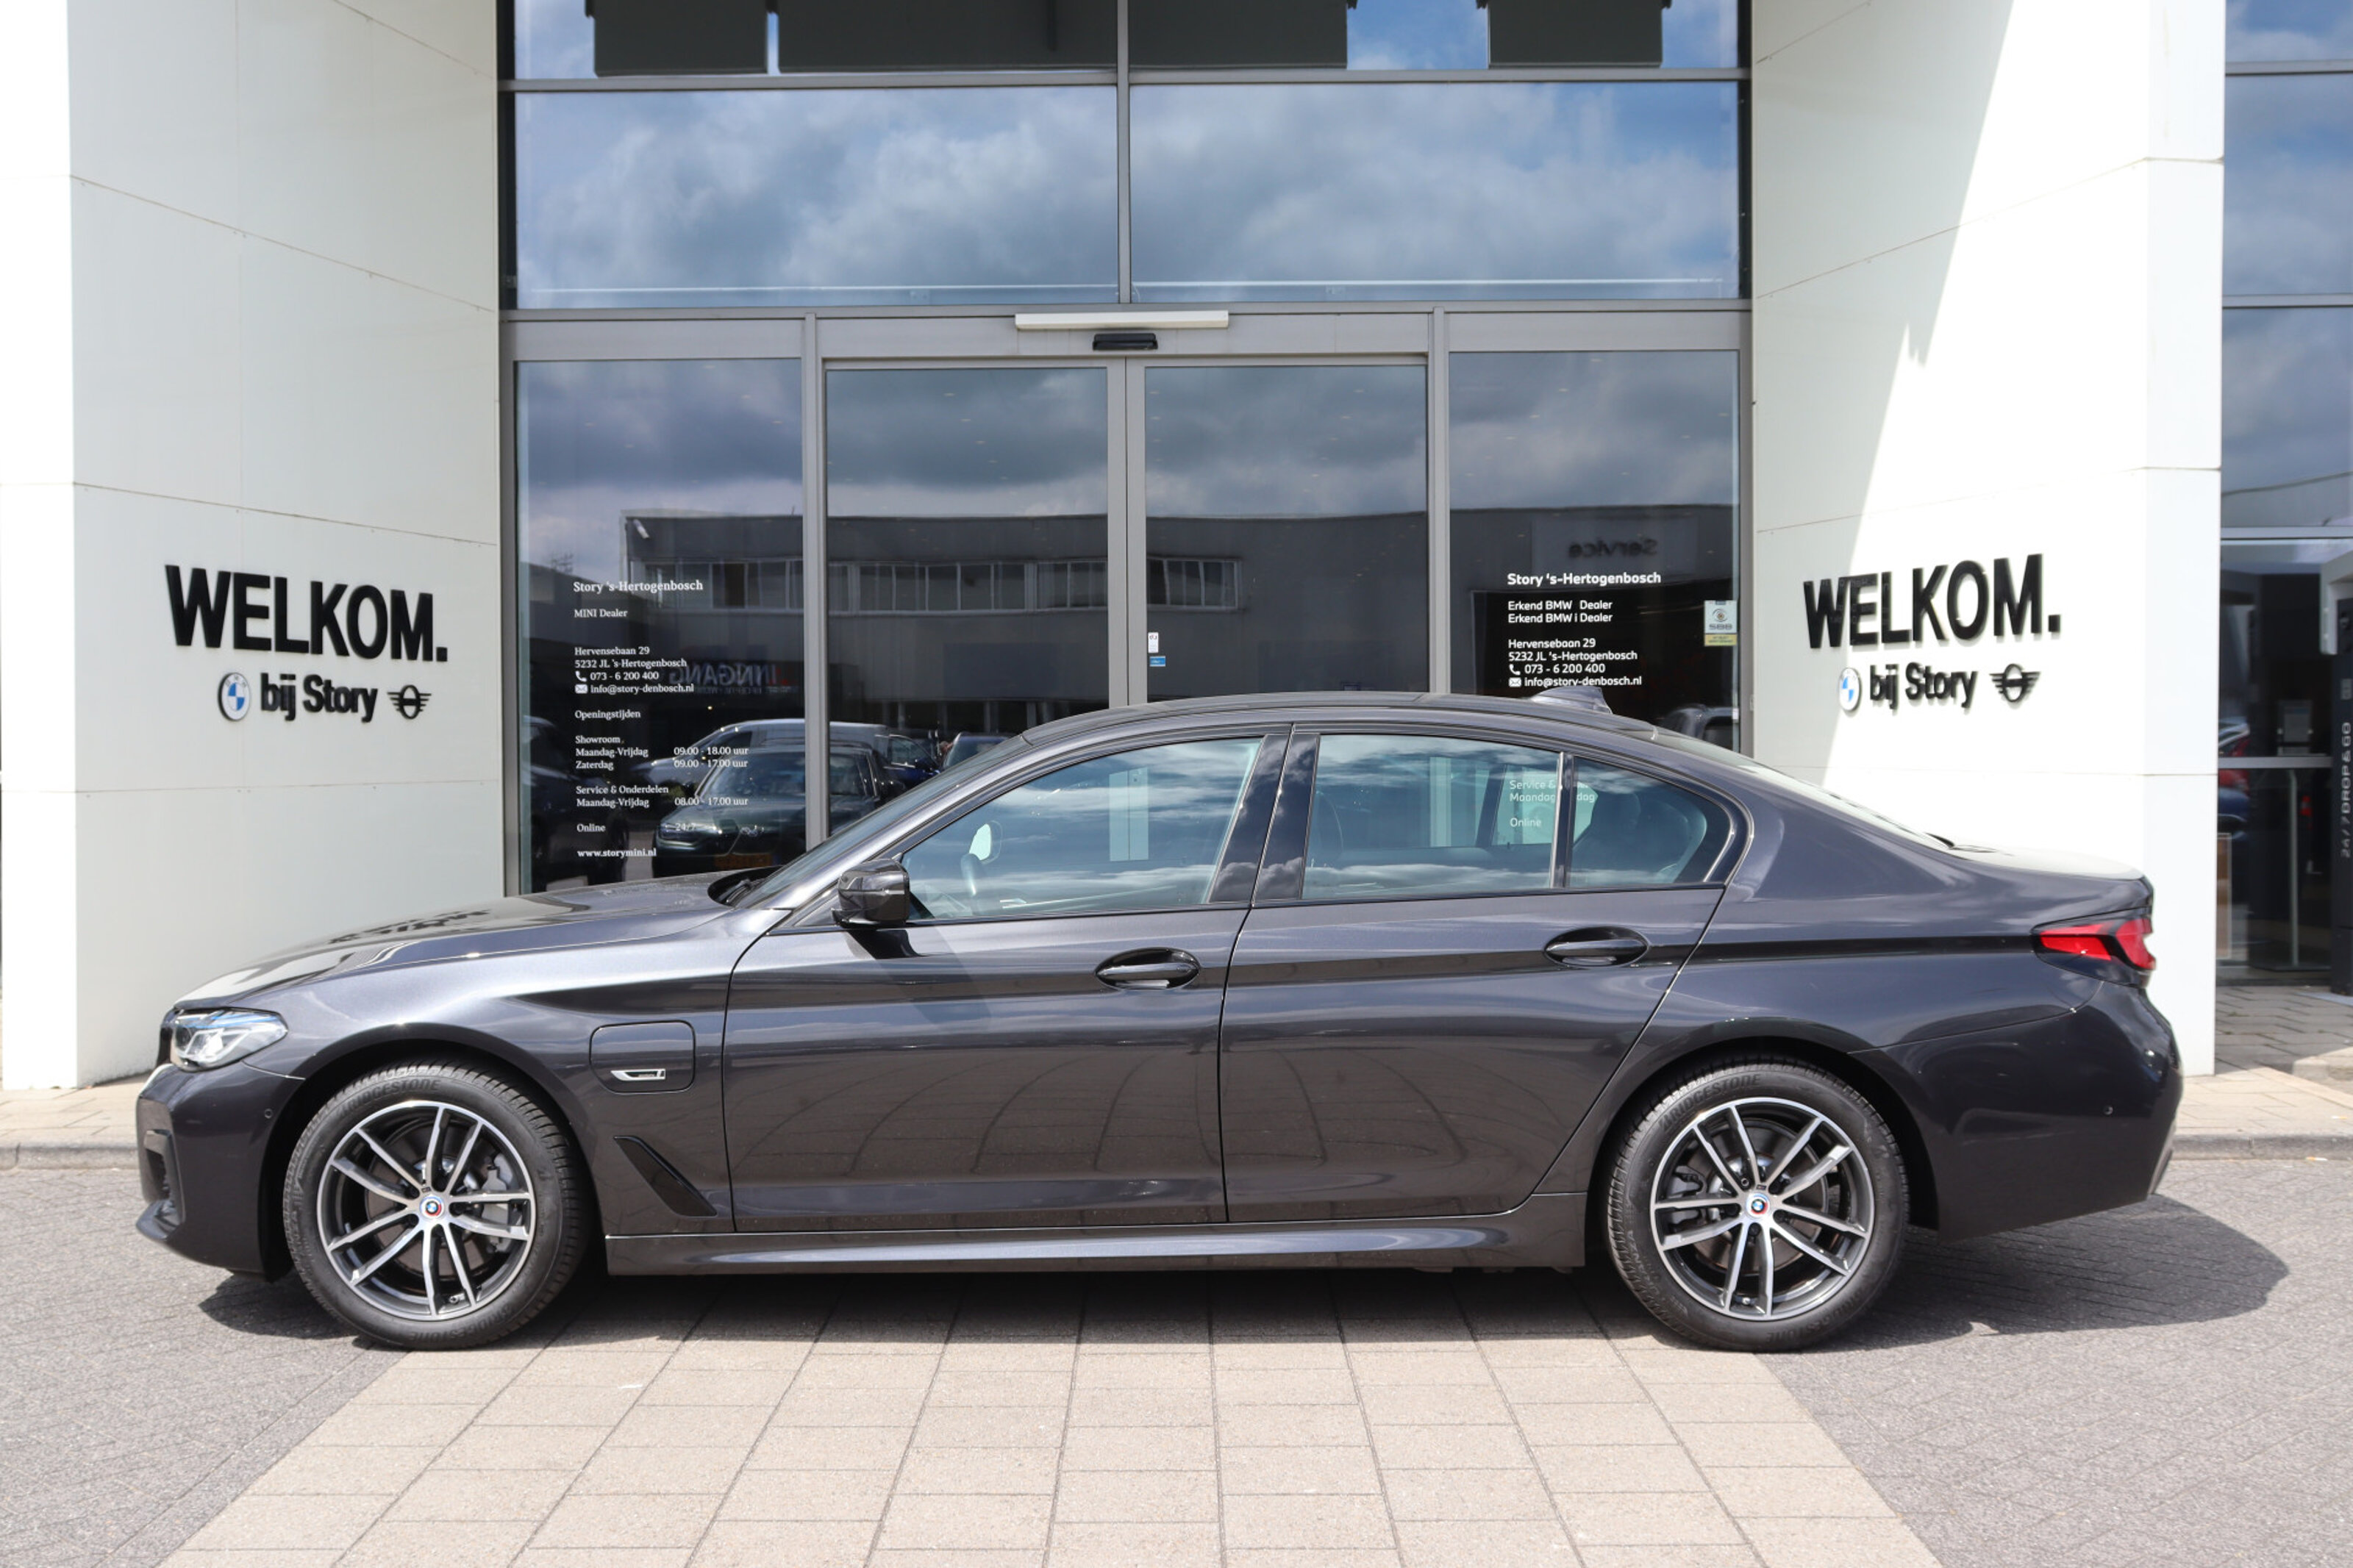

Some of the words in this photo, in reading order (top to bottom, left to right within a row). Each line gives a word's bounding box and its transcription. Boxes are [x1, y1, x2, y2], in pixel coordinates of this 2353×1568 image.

[1507, 573, 1543, 587] Story
[573, 581, 603, 594] Story
[1508, 601, 1543, 611] Erkend
[1546, 601, 1572, 610] BMW
[1579, 600, 1613, 610] Dealer
[1803, 554, 2062, 648] WELKOM.
[165, 564, 448, 662] WELKOM.
[574, 609, 597, 618] MINI
[599, 608, 628, 617] Dealer
[1508, 613, 1543, 623] Erkend
[1546, 613, 1572, 623] BMW
[1574, 612, 1578, 623] i
[1579, 612, 1613, 623] Dealer
[1508, 639, 1580, 649] Hervensebaan
[1583, 638, 1596, 648] 29
[574, 646, 636, 656] Hervensebaan
[638, 646, 650, 655] 29
[1509, 651, 1533, 662] 5232
[1535, 651, 1546, 662] JL
[575, 659, 598, 668] 5232
[599, 659, 610, 668] JL
[1524, 664, 1543, 674] 073
[1553, 664, 1560, 673] 6
[1562, 663, 1582, 673] 200
[1585, 663, 1606, 673] 400
[590, 672, 607, 681] 073
[615, 671, 621, 680] 6
[623, 671, 640, 680] 200
[642, 671, 660, 680] 400
[1524, 676, 1642, 687] info@story-denbosch.nl
[590, 682, 694, 695] info@story-denbosch.nl
[1870, 664, 1899, 710] bij
[1905, 662, 1979, 709] Story
[260, 673, 296, 722] bij
[302, 674, 378, 723] Story
[575, 709, 641, 720] Openingstijden
[576, 734, 621, 744] Showroom
[576, 746, 649, 758] Maandag-Vrijdag
[674, 746, 699, 756] 09.00
[707, 746, 732, 755] 18.00
[576, 759, 614, 771] Zaterdag
[674, 759, 699, 768] 09.00
[707, 759, 732, 767] 17.00
[576, 785, 609, 795] Service
[619, 784, 668, 794] Onderdelen
[1510, 780, 1546, 790] Service
[1548, 779, 1556, 789] &
[576, 797, 650, 809] Maandag-Vrijdag
[674, 797, 699, 806] 08.00
[707, 796, 732, 806] 17.00
[576, 823, 606, 832] Online
[1510, 817, 1542, 827] Online
[577, 848, 657, 859] www.storymini.nl
